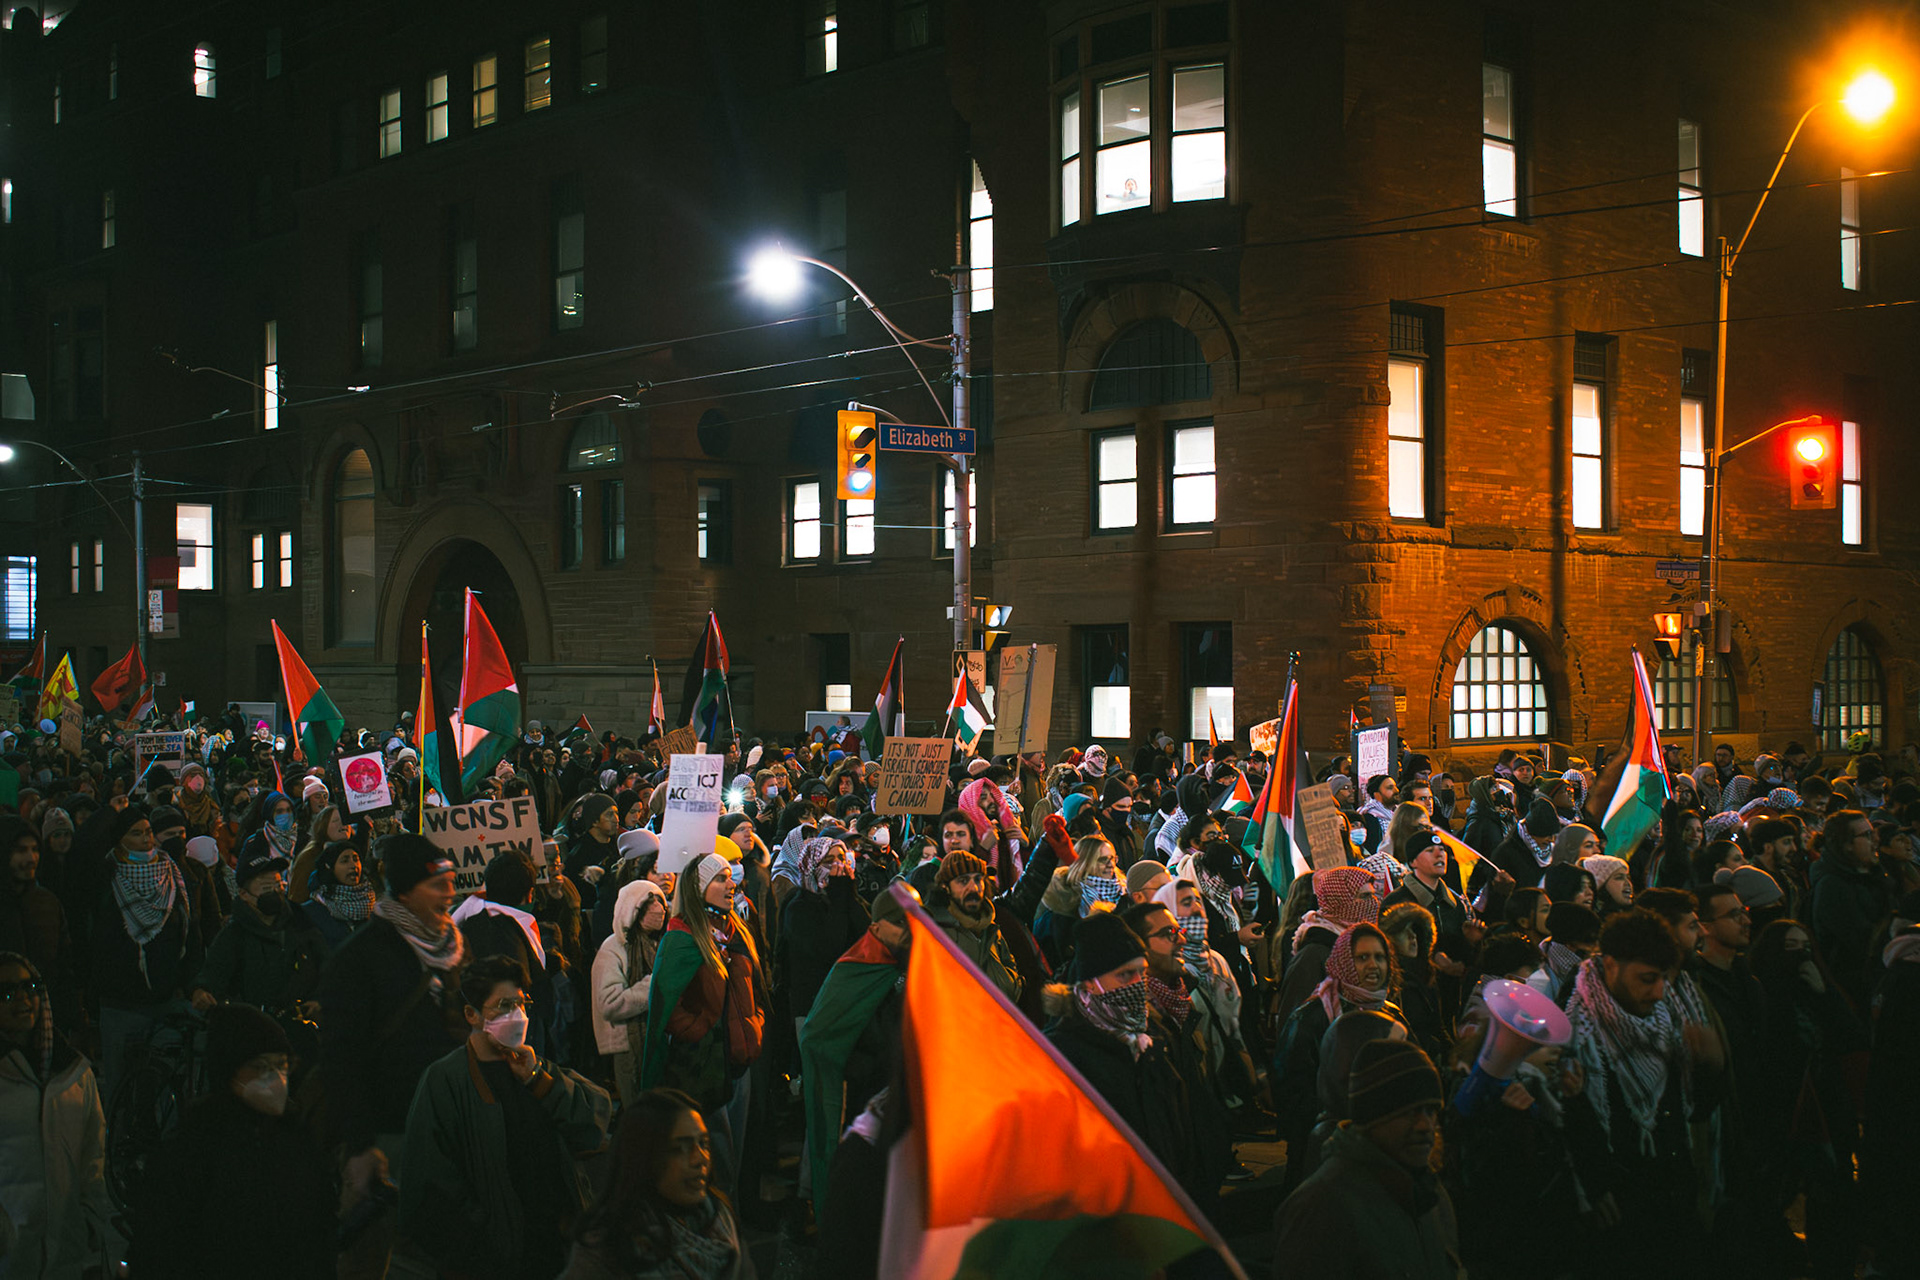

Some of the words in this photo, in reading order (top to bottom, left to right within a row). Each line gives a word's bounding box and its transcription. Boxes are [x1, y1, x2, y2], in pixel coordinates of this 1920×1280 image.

[889, 428, 953, 448] Elizabeth
[904, 743, 921, 758] NOT
[922, 743, 944, 759] JUST
[697, 773, 718, 788] ICJ
[901, 774, 926, 790] YOURS
[927, 775, 942, 790] TOO
[888, 789, 929, 808] CANADA
[424, 799, 531, 833] WCNSF
